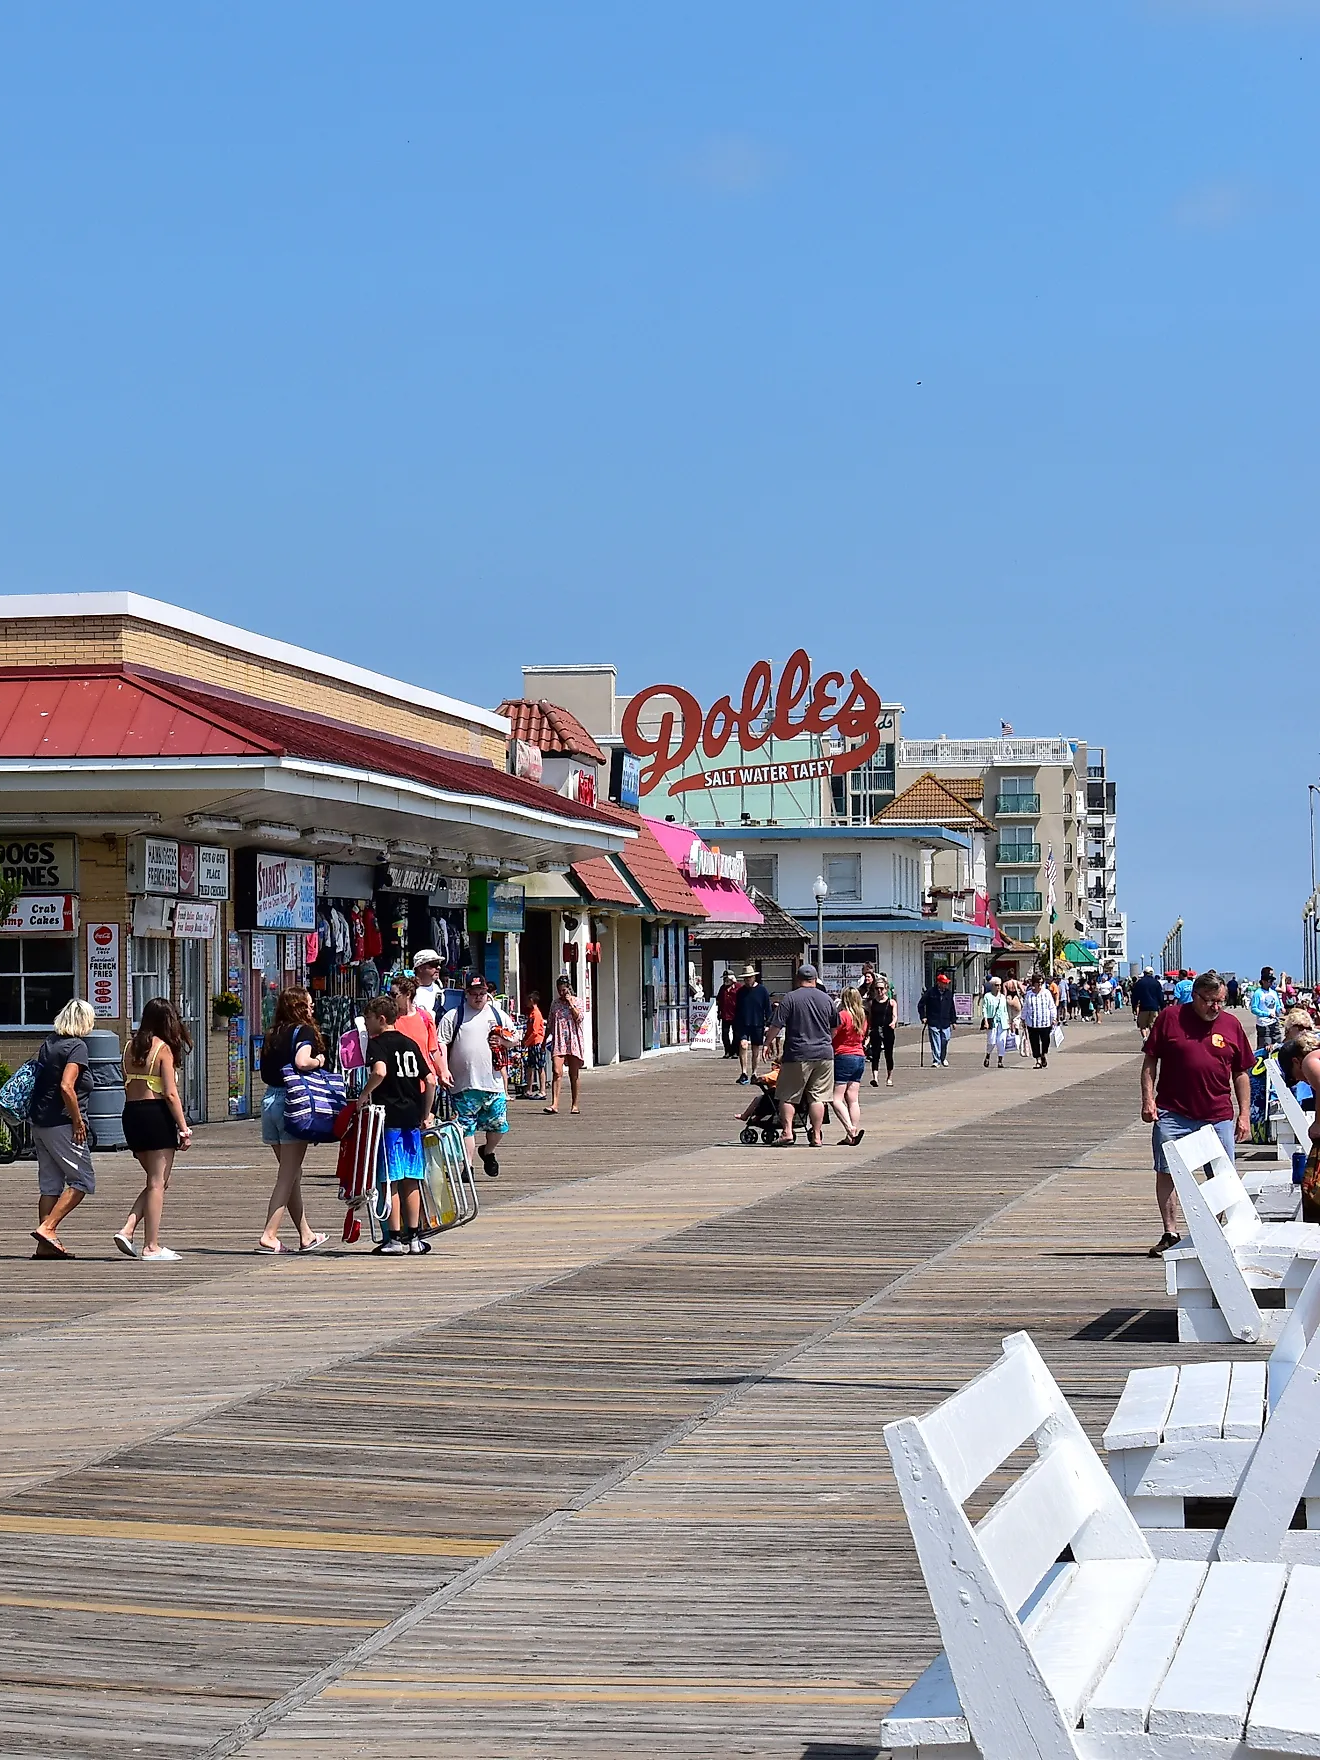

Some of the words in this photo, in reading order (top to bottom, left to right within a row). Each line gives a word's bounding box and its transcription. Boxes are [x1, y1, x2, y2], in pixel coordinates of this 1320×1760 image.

[704, 770, 736, 788] SALT
[738, 765, 789, 784] WATER
[791, 759, 834, 780] TAFFY
[206, 868, 221, 880] PLACE
[31, 903, 57, 914] Crab
[29, 916, 60, 925] Cakes
[89, 962, 117, 970] FRENCH
[93, 970, 113, 978] FRIES
[394, 1050, 420, 1078] 10
